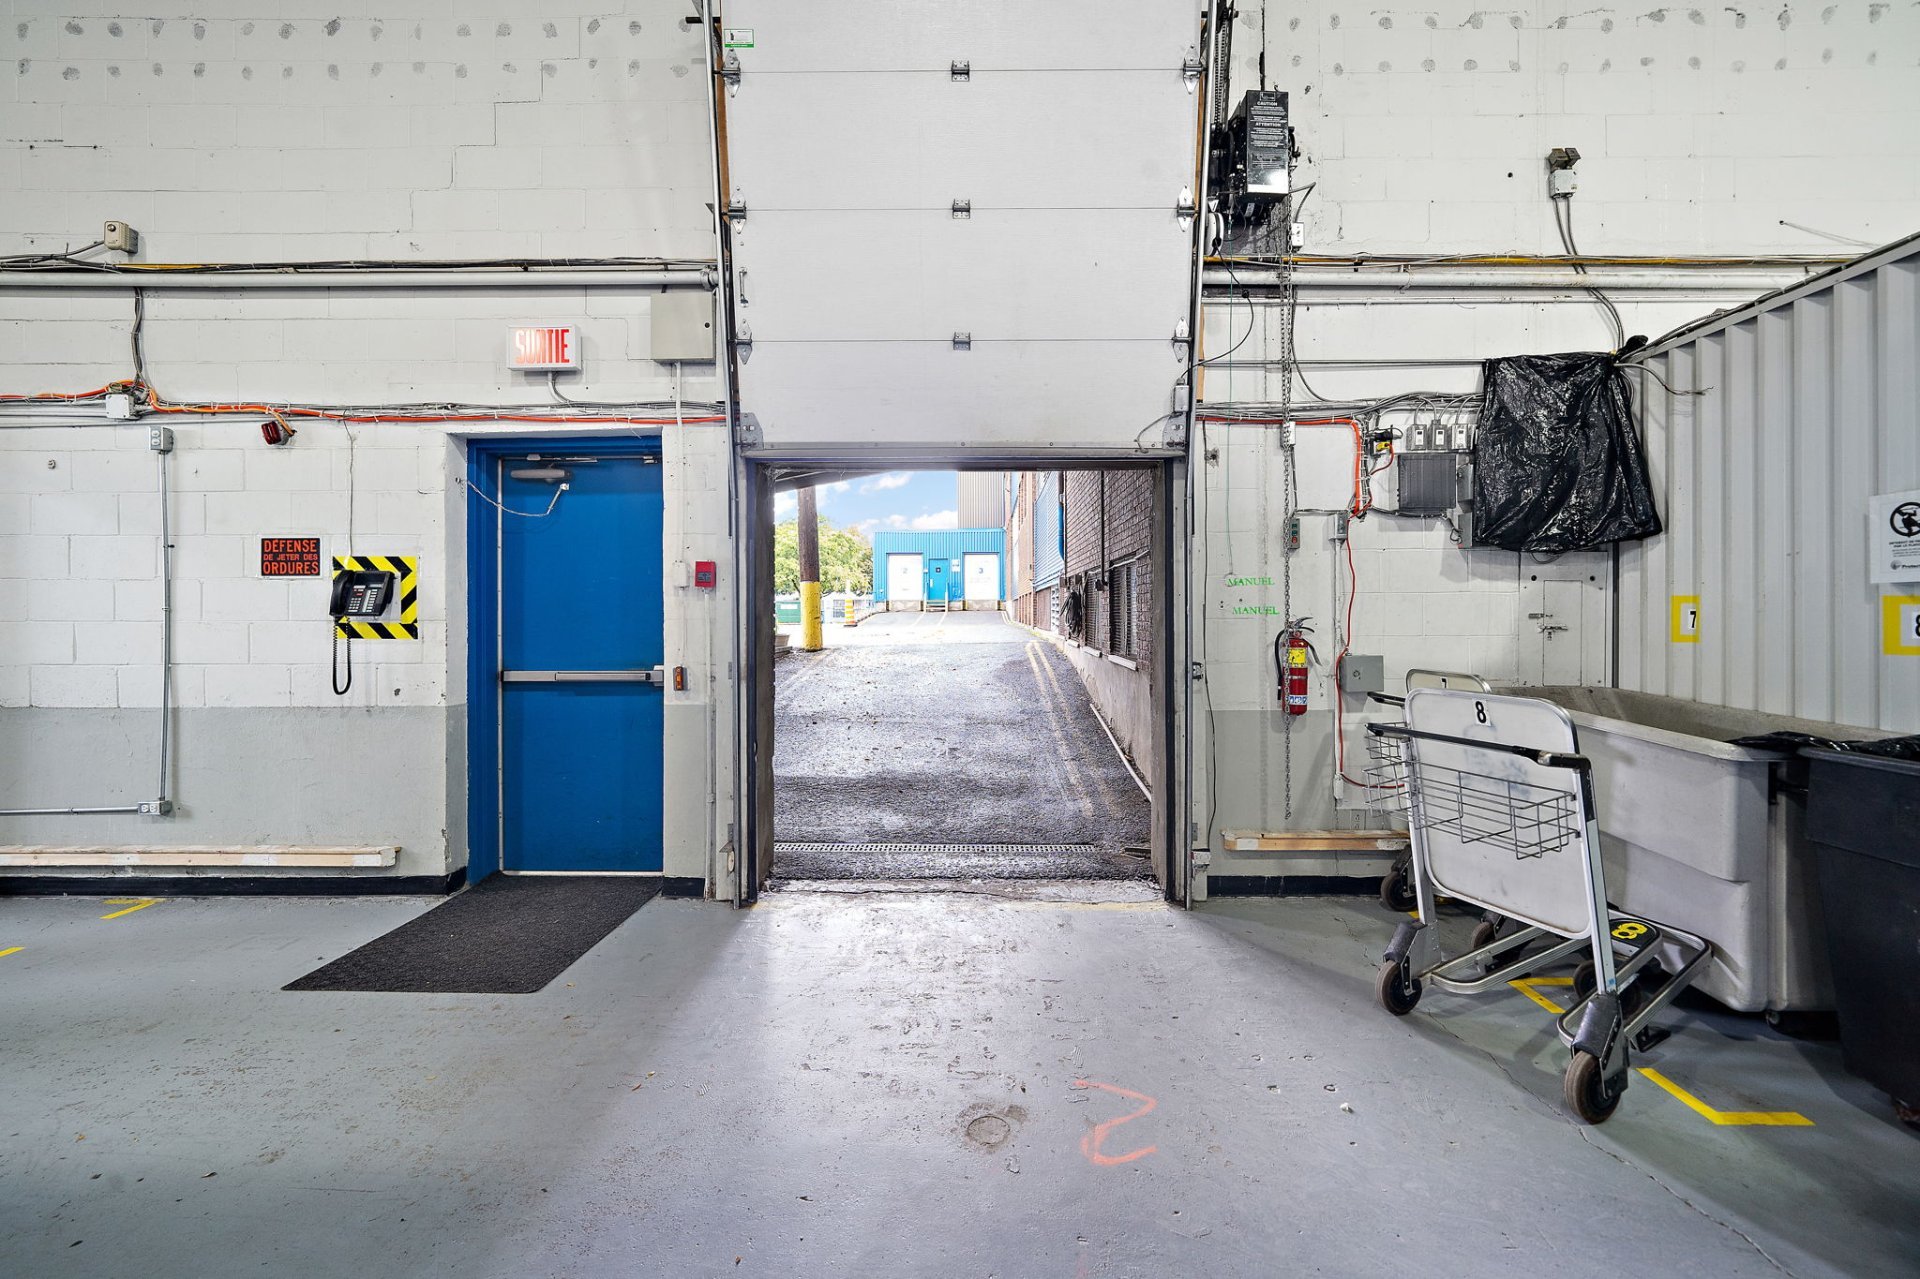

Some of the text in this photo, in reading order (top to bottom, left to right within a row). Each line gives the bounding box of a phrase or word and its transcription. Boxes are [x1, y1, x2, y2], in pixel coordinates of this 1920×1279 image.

[515, 329, 569, 363] SORTIE
[263, 561, 318, 575] ORDURES
[1227, 577, 1275, 586] MANUEL
[1233, 606, 1280, 615] MANUEL
[1690, 610, 1697, 628] 7
[1475, 701, 1486, 723] 8
[1611, 922, 1647, 939] 8
